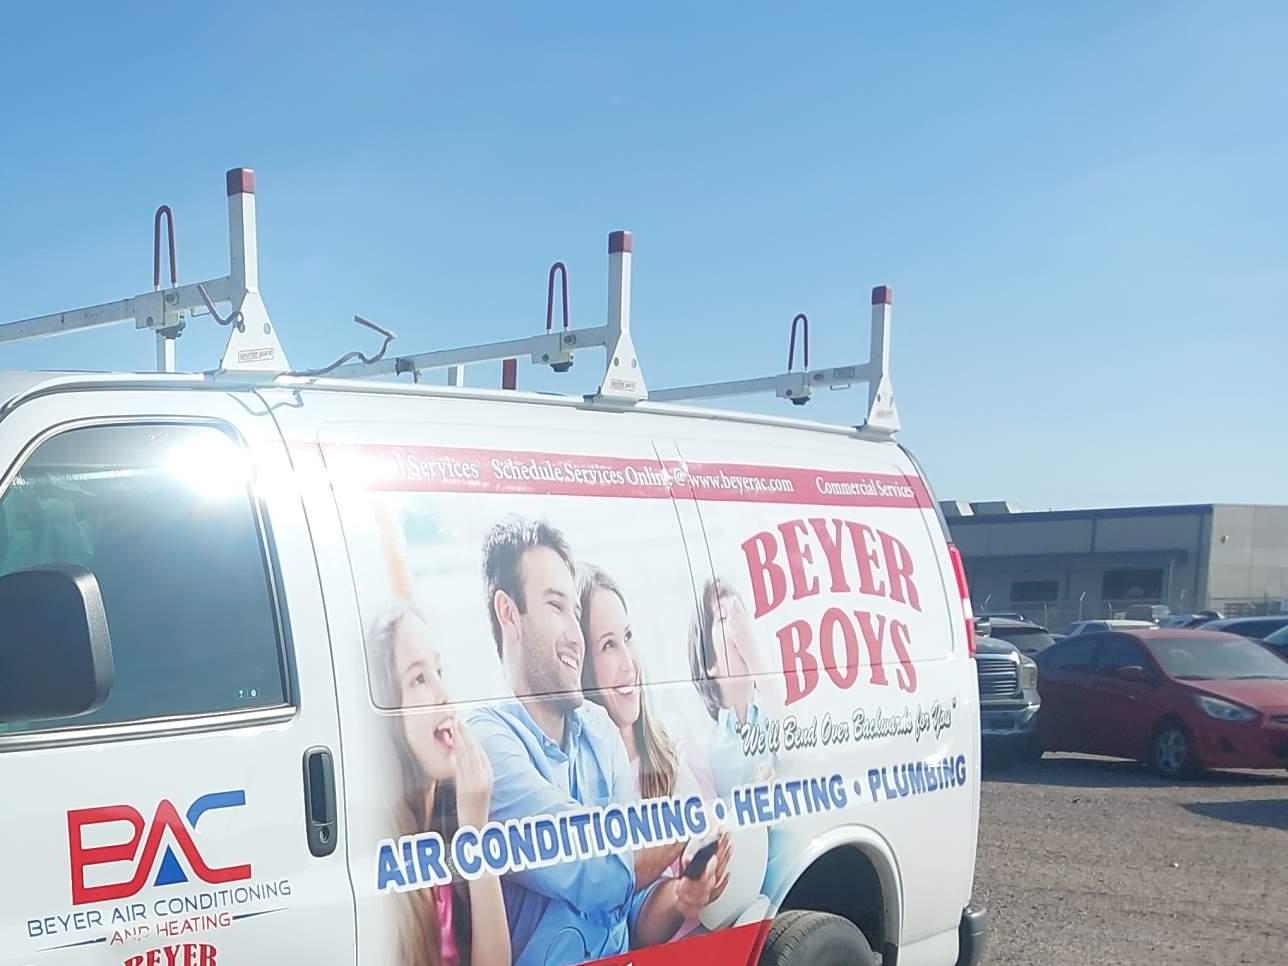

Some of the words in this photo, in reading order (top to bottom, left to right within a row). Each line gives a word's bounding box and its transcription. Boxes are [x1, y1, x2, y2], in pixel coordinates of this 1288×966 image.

[408, 454, 480, 478] Services
[492, 457, 561, 481] Schedule
[563, 462, 625, 485] Services
[688, 469, 794, 494] www.beyerac.com
[816, 476, 876, 496] Commercial
[877, 479, 914, 498] Services
[741, 518, 921, 619] BEYER
[776, 607, 917, 706] BOYS
[783, 714, 817, 751] Bend
[821, 711, 849, 744] Over
[852, 707, 912, 743] Backwards
[914, 706, 931, 741] for
[67, 790, 252, 906] BAC
[377, 838, 448, 890] AIR
[455, 798, 707, 875] CONDITIONING
[735, 773, 847, 825] HEATING
[870, 754, 967, 802] PLUMBING
[27, 910, 103, 937] BEYER
[112, 904, 147, 924] AIR
[154, 880, 292, 917] CONDITIONING
[110, 926, 150, 946] AND
[156, 912, 232, 936] HEATING
